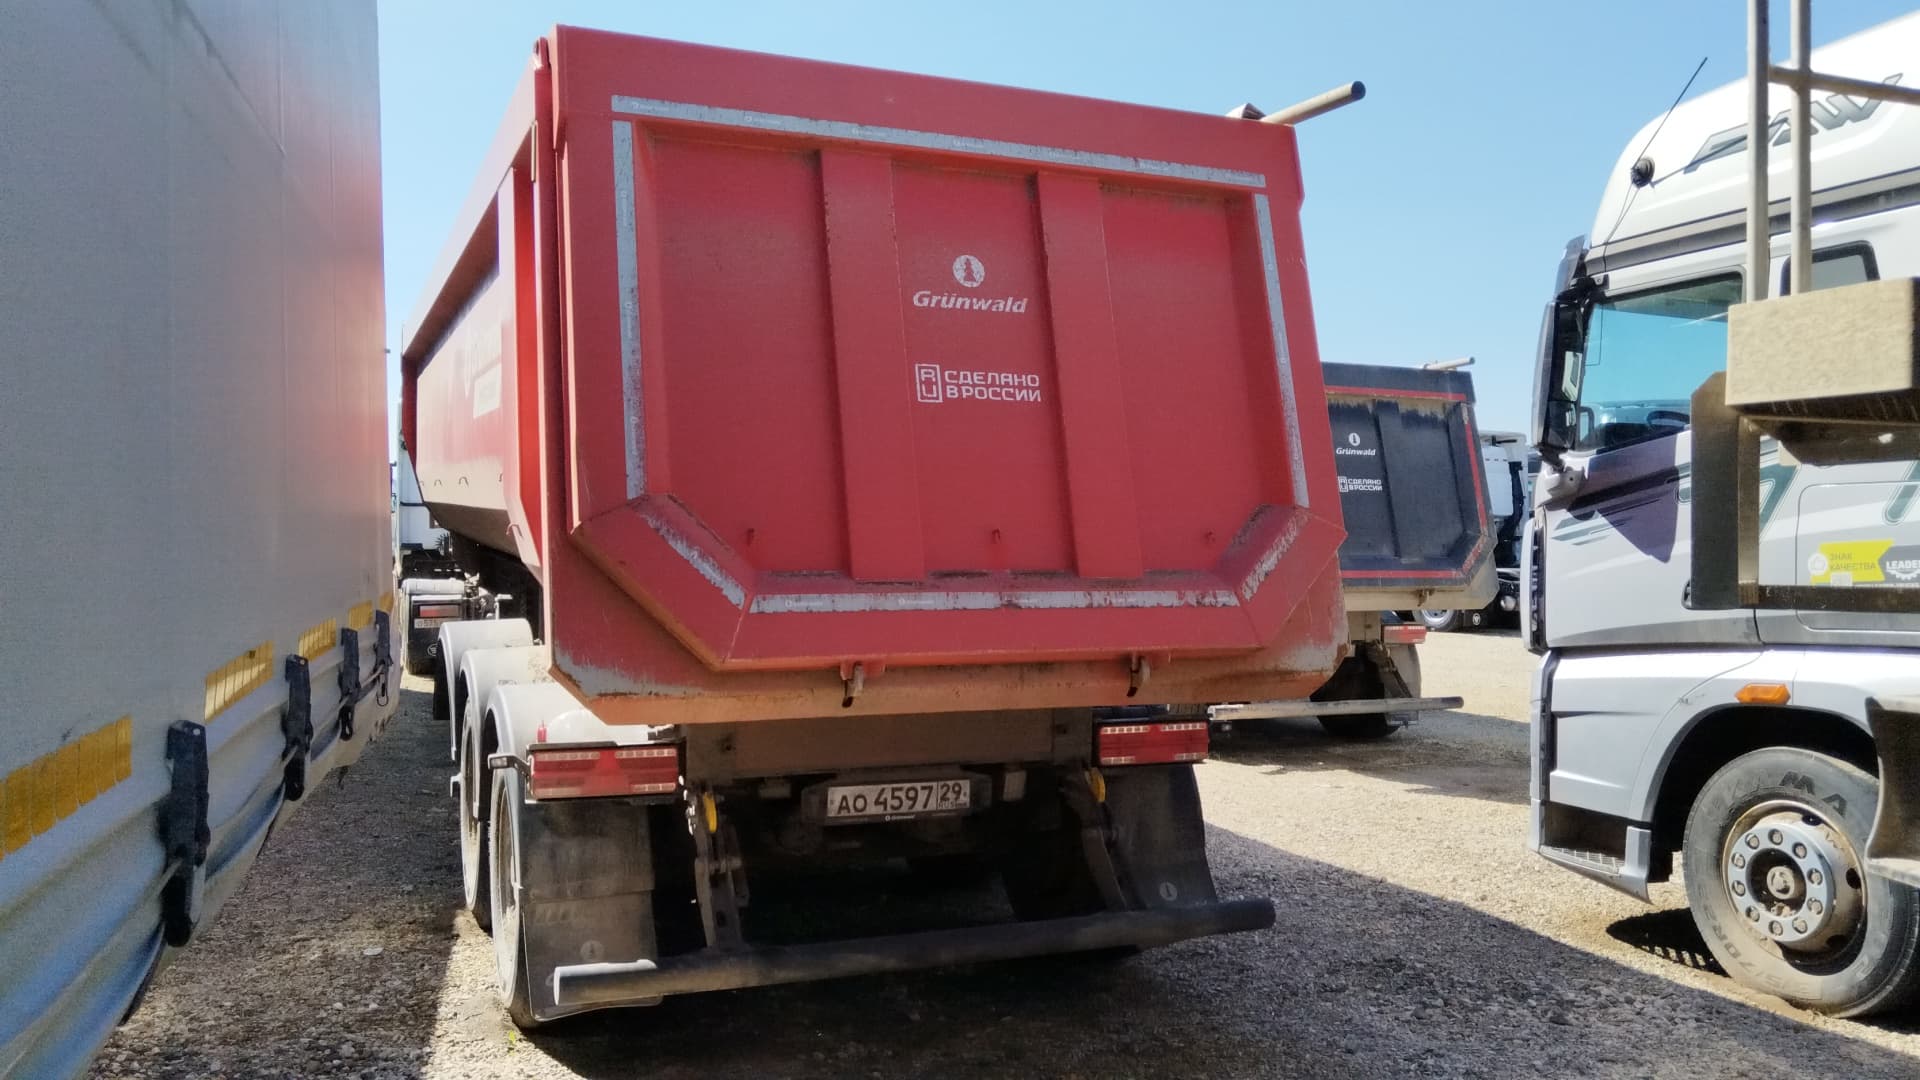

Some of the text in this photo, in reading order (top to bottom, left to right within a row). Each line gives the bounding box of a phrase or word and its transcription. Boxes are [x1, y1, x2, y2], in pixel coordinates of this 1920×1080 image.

[912, 290, 1029, 313] Grünwald
[944, 370, 1040, 387] СДЕЛАНО
[1336, 447, 1376, 456] Grünwald
[1886, 560, 1920, 569] LEADE
[837, 782, 962, 815] АО 4597 29
